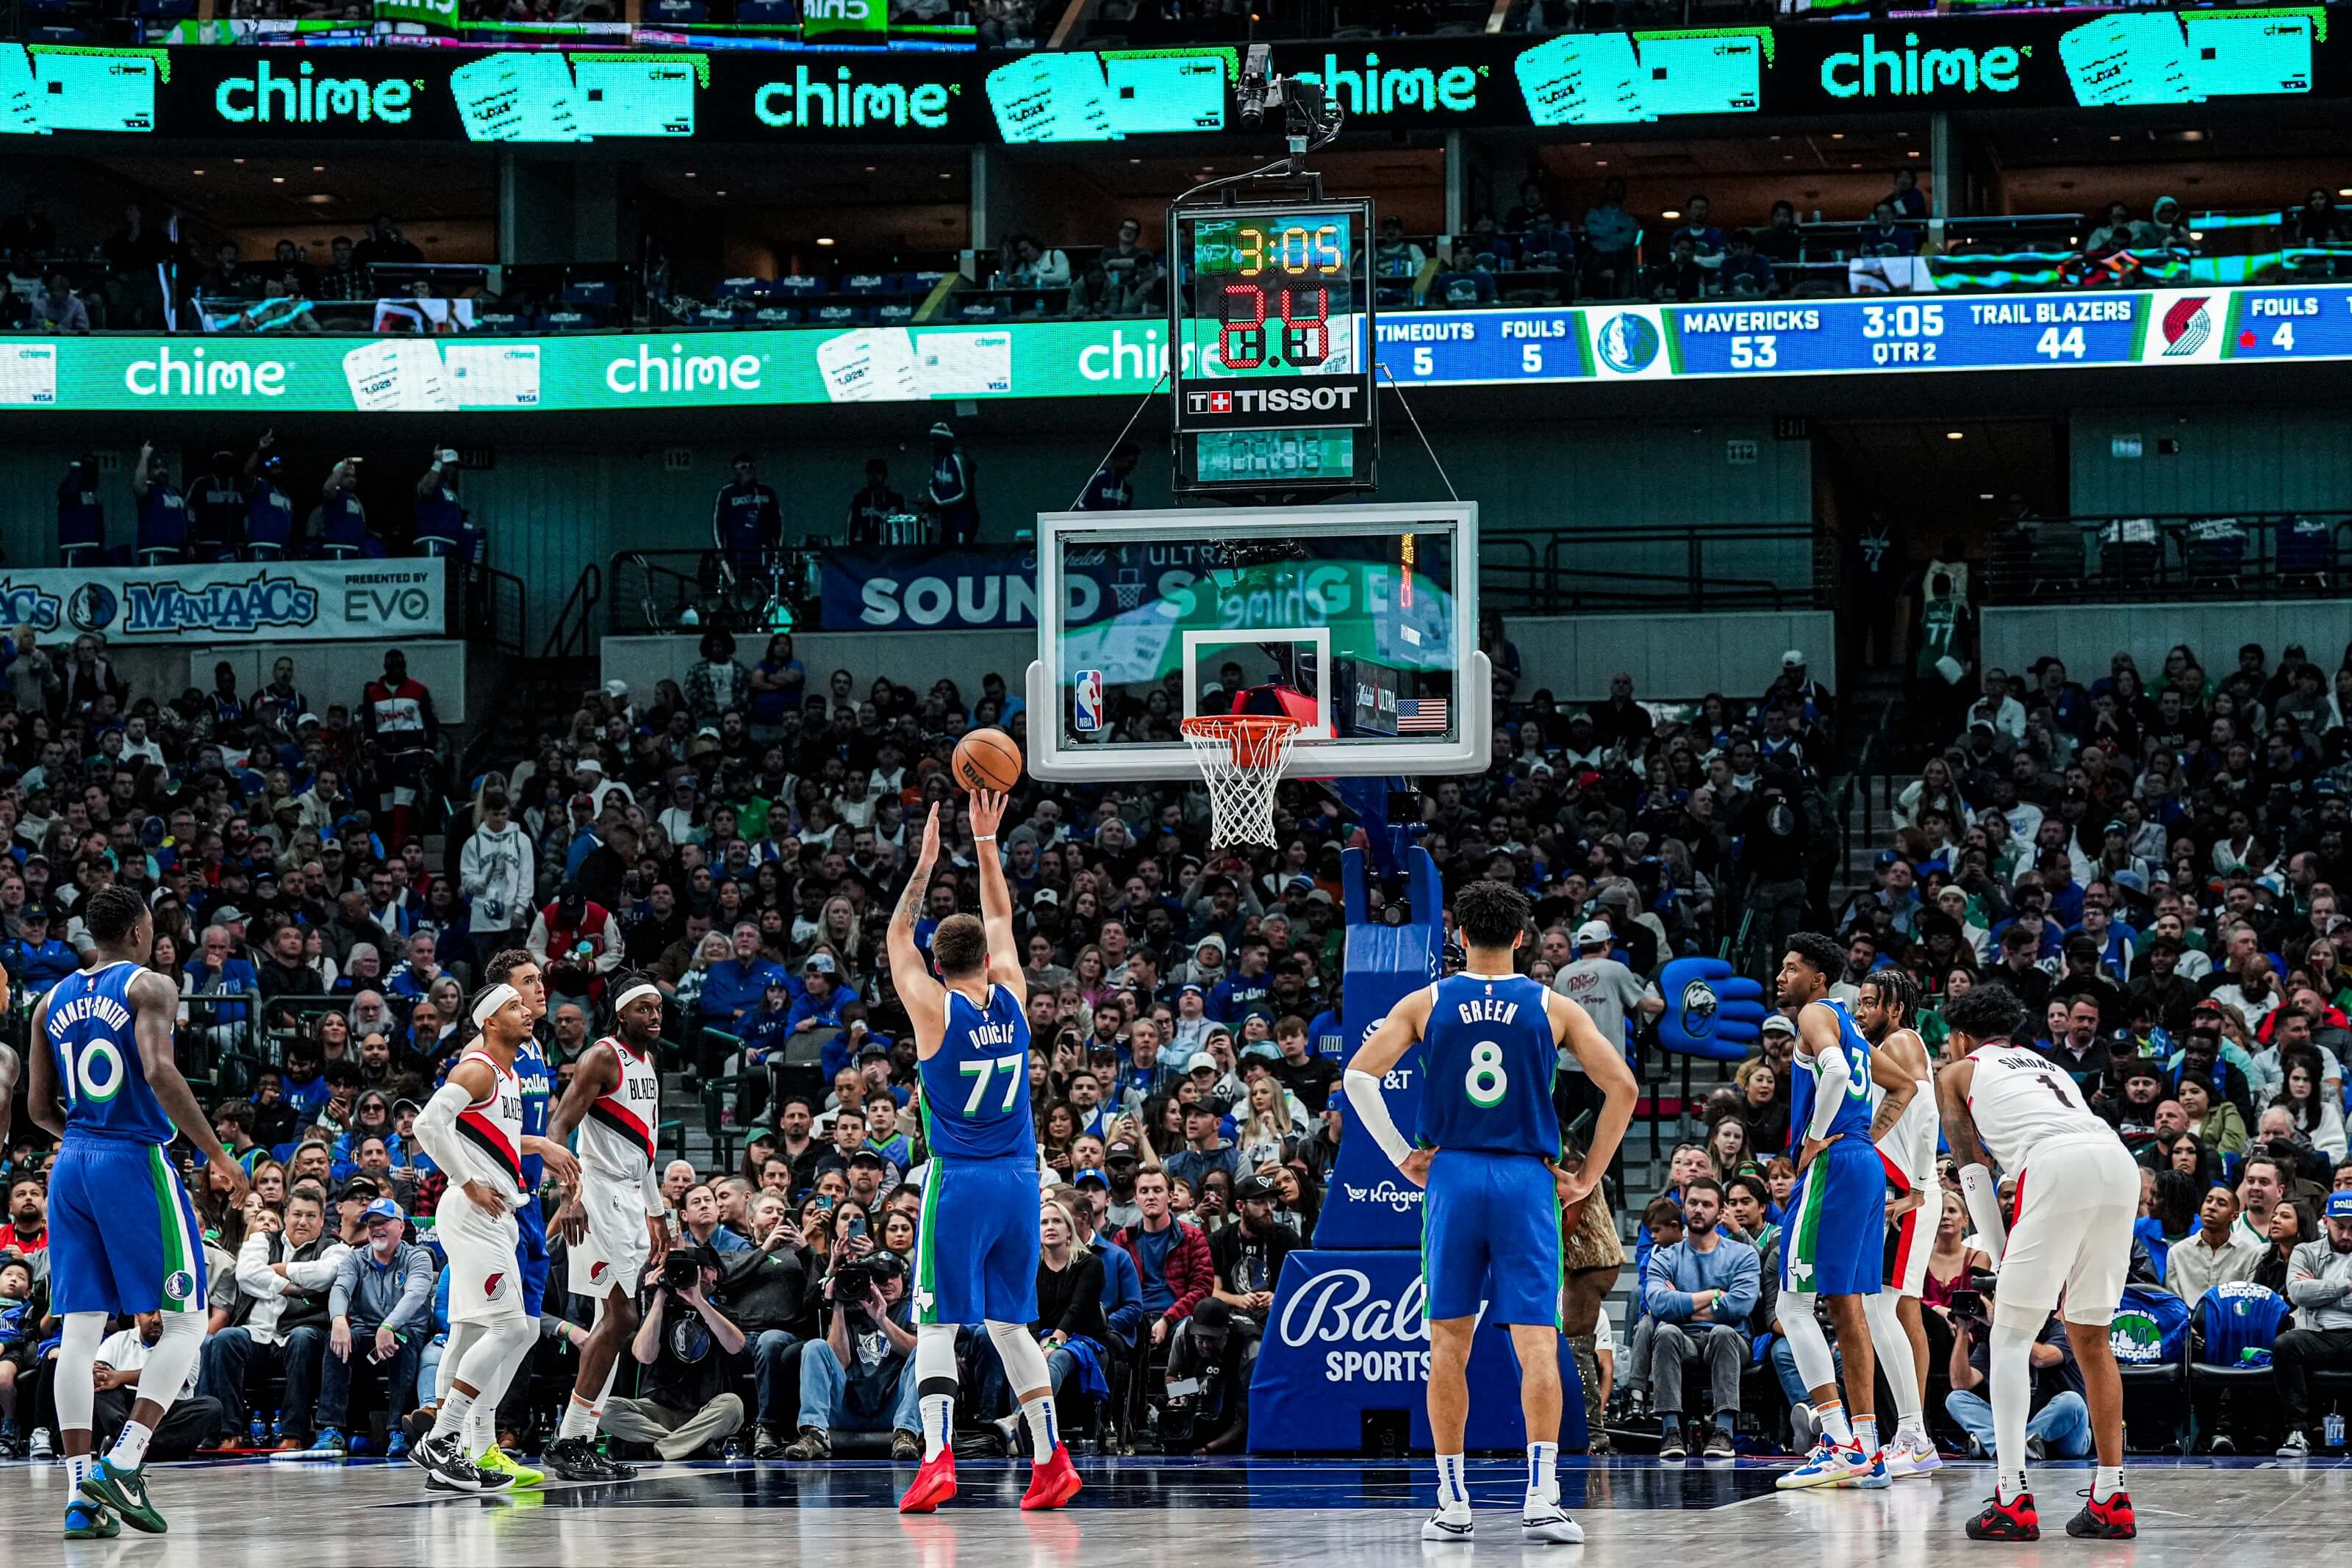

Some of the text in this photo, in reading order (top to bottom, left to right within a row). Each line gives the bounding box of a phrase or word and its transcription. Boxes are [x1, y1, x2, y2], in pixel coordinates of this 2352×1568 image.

[1821, 32, 2020, 98] chime
[216, 60, 412, 123] chime
[755, 65, 947, 127] chime
[1241, 226, 1341, 276] 3:05
[1683, 310, 1820, 334] MAVERICKS
[1862, 304, 1944, 338] 3:05
[1971, 301, 2132, 326] TRAIL BLAZERS
[2251, 297, 2319, 317] FOULS
[1219, 284, 1329, 368] 24
[1375, 322, 1475, 342] TIMEOUTS
[1501, 320, 1566, 339] FOULS
[2272, 322, 2294, 351] 4
[1730, 335, 1777, 369] 53
[1872, 342, 1937, 365] QTR 2
[2035, 326, 2087, 359] 44
[126, 346, 286, 396] chime
[606, 342, 761, 393] chime
[1413, 347, 1433, 375] 5
[1521, 344, 1543, 373] 5
[1235, 386, 1358, 412] TISSOT
[1149, 546, 1231, 566] ULTRA
[345, 572, 429, 584] PRESENTED BY
[345, 589, 429, 622] EVO
[860, 565, 1388, 627] SOUND SGE
[1079, 717, 1093, 727] NBA
[49, 995, 131, 1040] FINNEY-SMITH
[1458, 999, 1519, 1024] GREEN
[60, 1037, 124, 1105] 10
[1379, 1070, 1413, 1089] &T
[1465, 1040, 1507, 1108] 8
[1998, 1057, 2058, 1073] SIMONS
[959, 1052, 1023, 1118] 77
[2034, 1073, 2076, 1109] 1
[501, 1095, 523, 1123] BLAZE
[534, 1101, 544, 1132] 7
[1370, 1180, 1424, 1212] Kroger
[684, 1310, 698, 1320] 77
[1280, 1269, 1489, 1348] Bal
[1325, 1351, 1432, 1382] SPORTS
